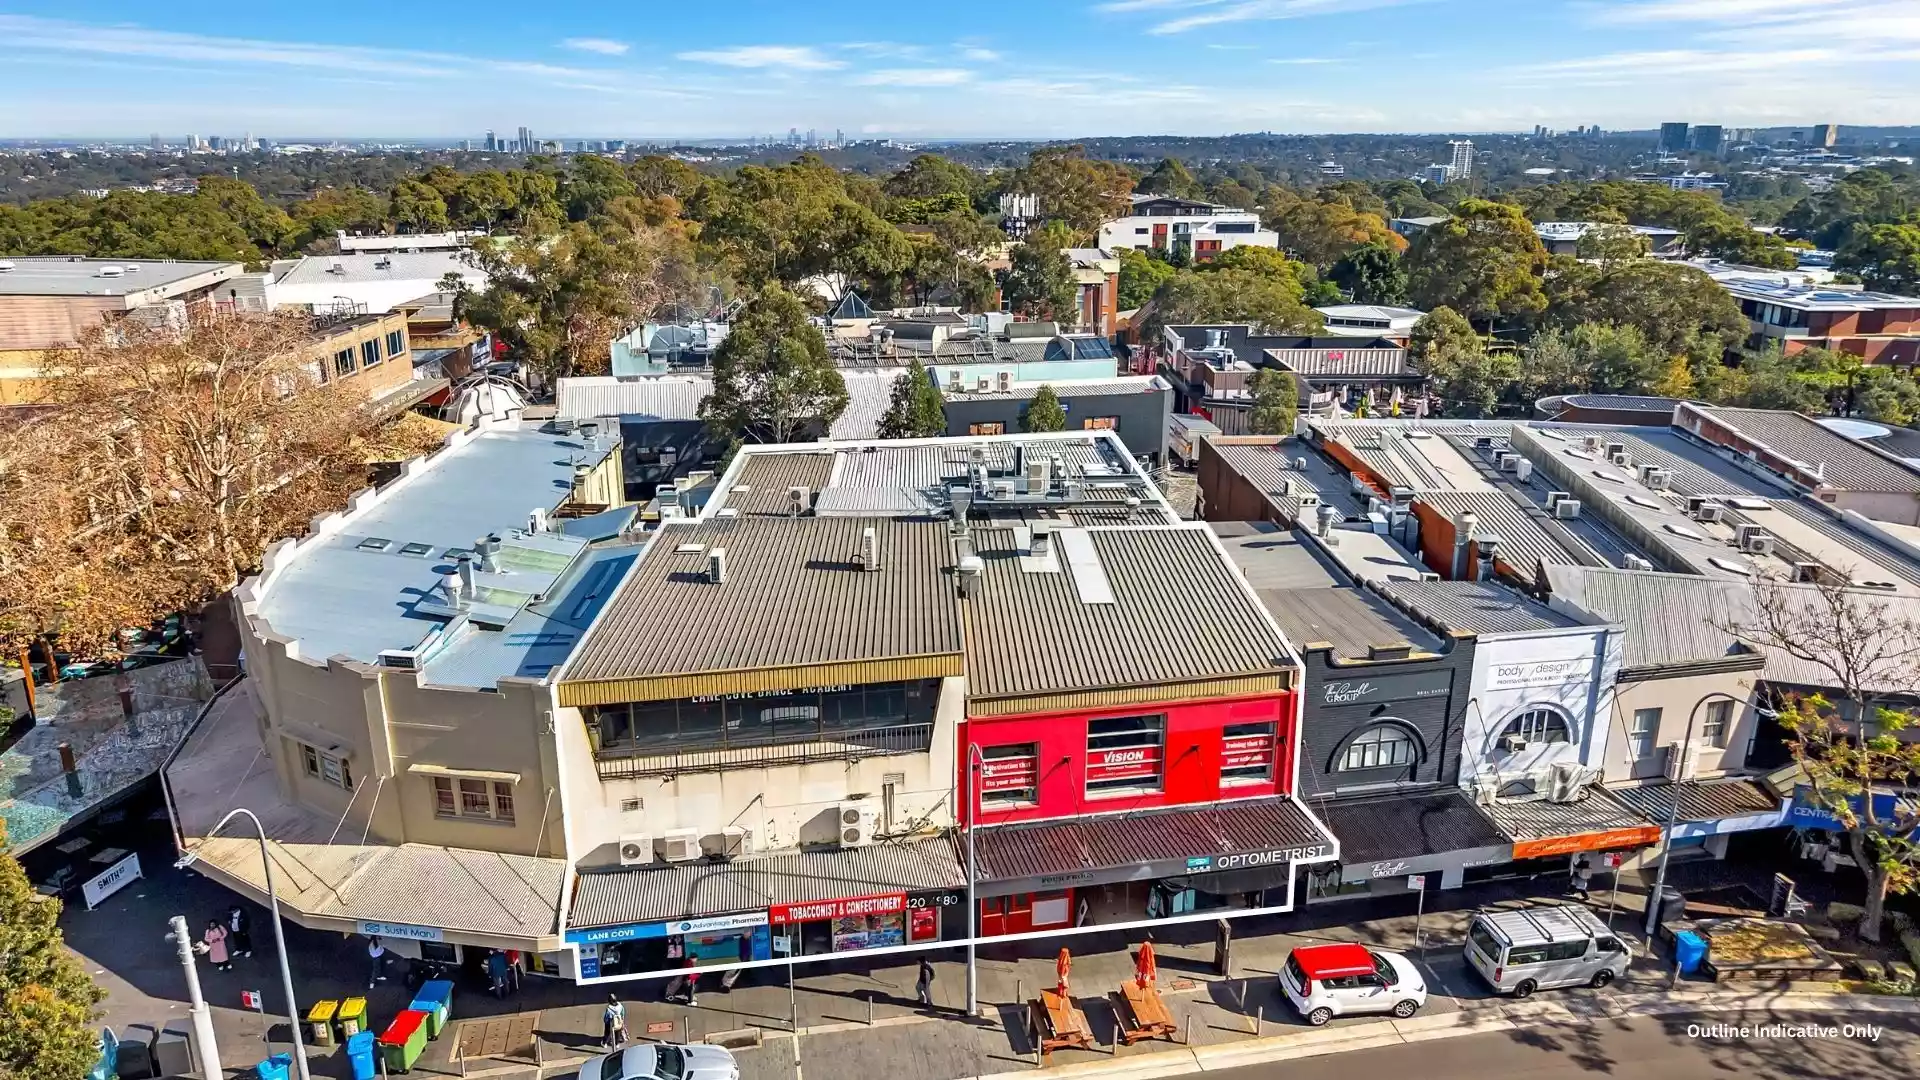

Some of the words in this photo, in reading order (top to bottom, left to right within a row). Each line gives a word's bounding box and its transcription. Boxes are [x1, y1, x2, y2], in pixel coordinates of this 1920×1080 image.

[1497, 665, 1524, 677] body
[1535, 663, 1569, 674] design
[1326, 692, 1359, 703] GROUP
[1103, 751, 1144, 763] VISION
[1217, 845, 1326, 868] OPTOMETRIST
[97, 870, 120, 890] SMITH
[788, 903, 837, 921] TOBACCONIST
[838, 902, 845, 915] &
[846, 896, 902, 914] CONFECTIONERY
[692, 919, 731, 930] Advantage
[731, 915, 766, 925] Pharmacy
[384, 925, 408, 935] Sushi
[410, 928, 436, 939] Maru
[587, 931, 609, 941] LANE
[611, 929, 635, 938] COVE
